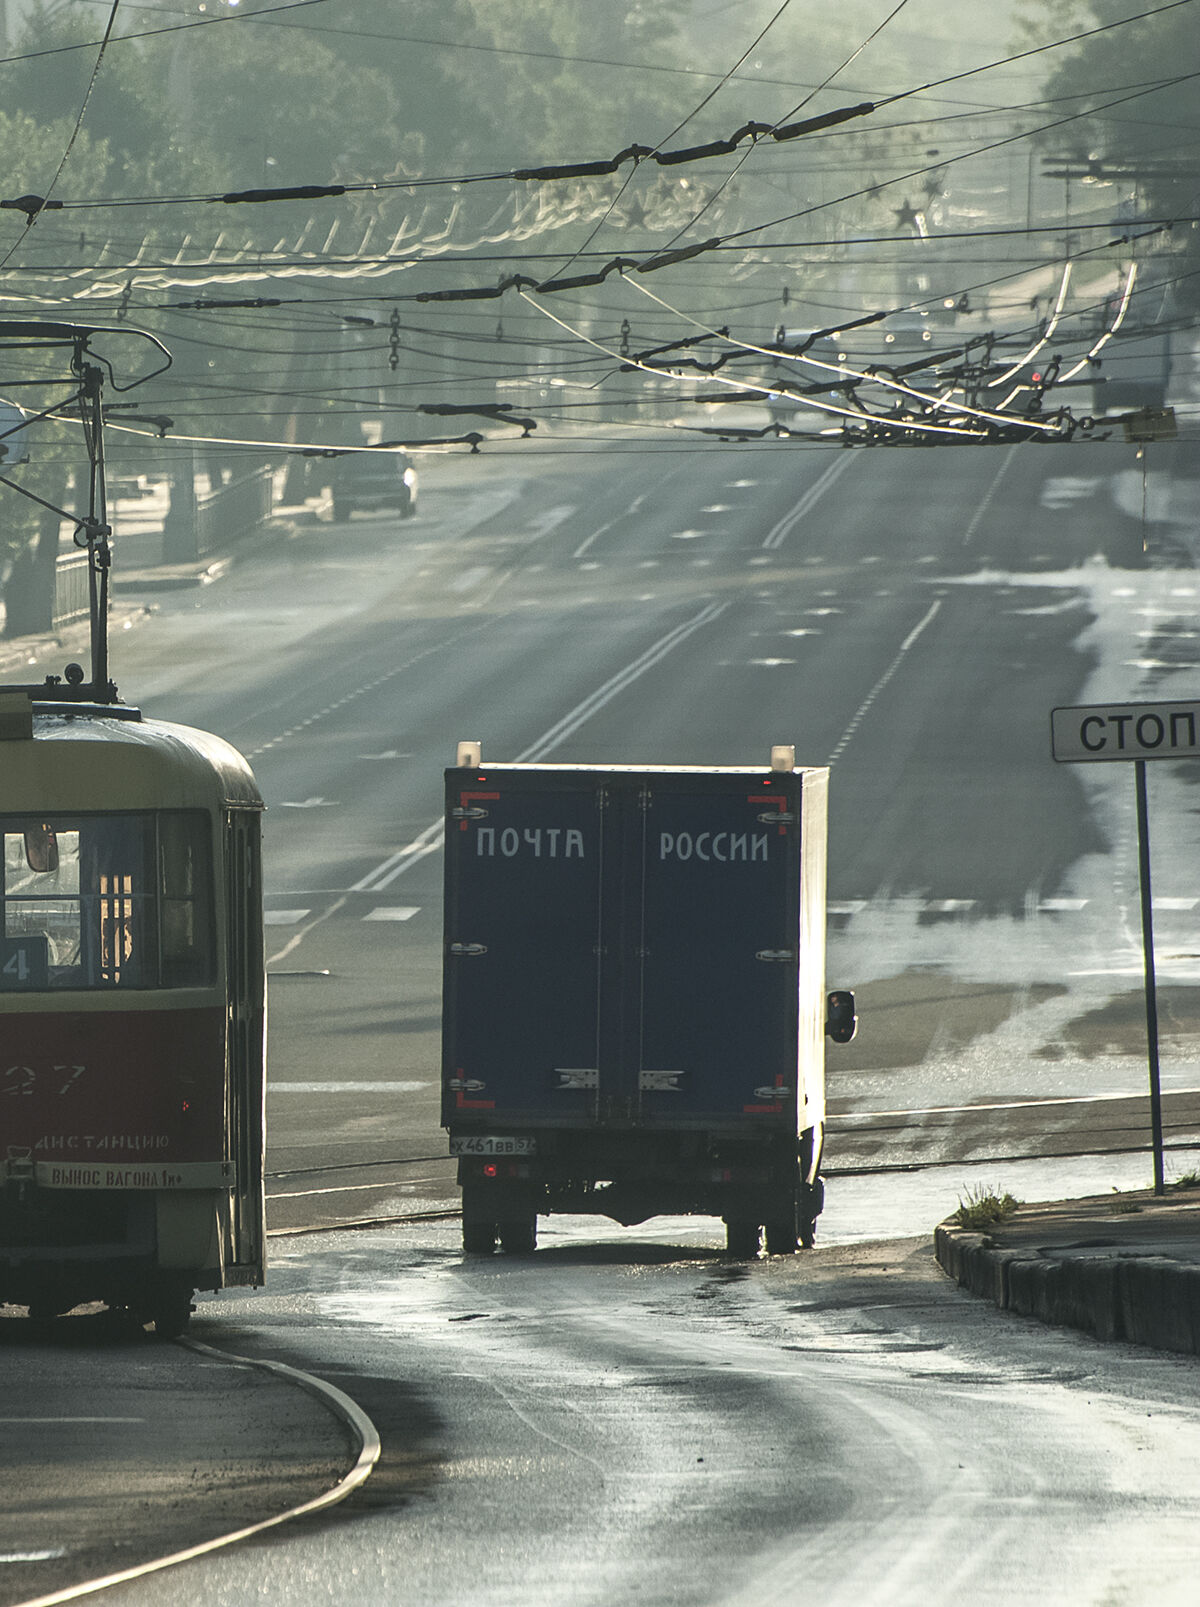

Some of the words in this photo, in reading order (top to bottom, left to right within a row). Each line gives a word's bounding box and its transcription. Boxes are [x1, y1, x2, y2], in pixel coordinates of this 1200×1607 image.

[1081, 712, 1196, 751] СТОП
[477, 828, 585, 858] ПОЧТА
[660, 832, 768, 862] РОССИИ
[3, 950, 29, 980] 4
[35, 1135, 169, 1150] ДИСТАНЦИЮ
[52, 1168, 100, 1186] ВЫНОС
[106, 1170, 158, 1187] ВАГОНА
